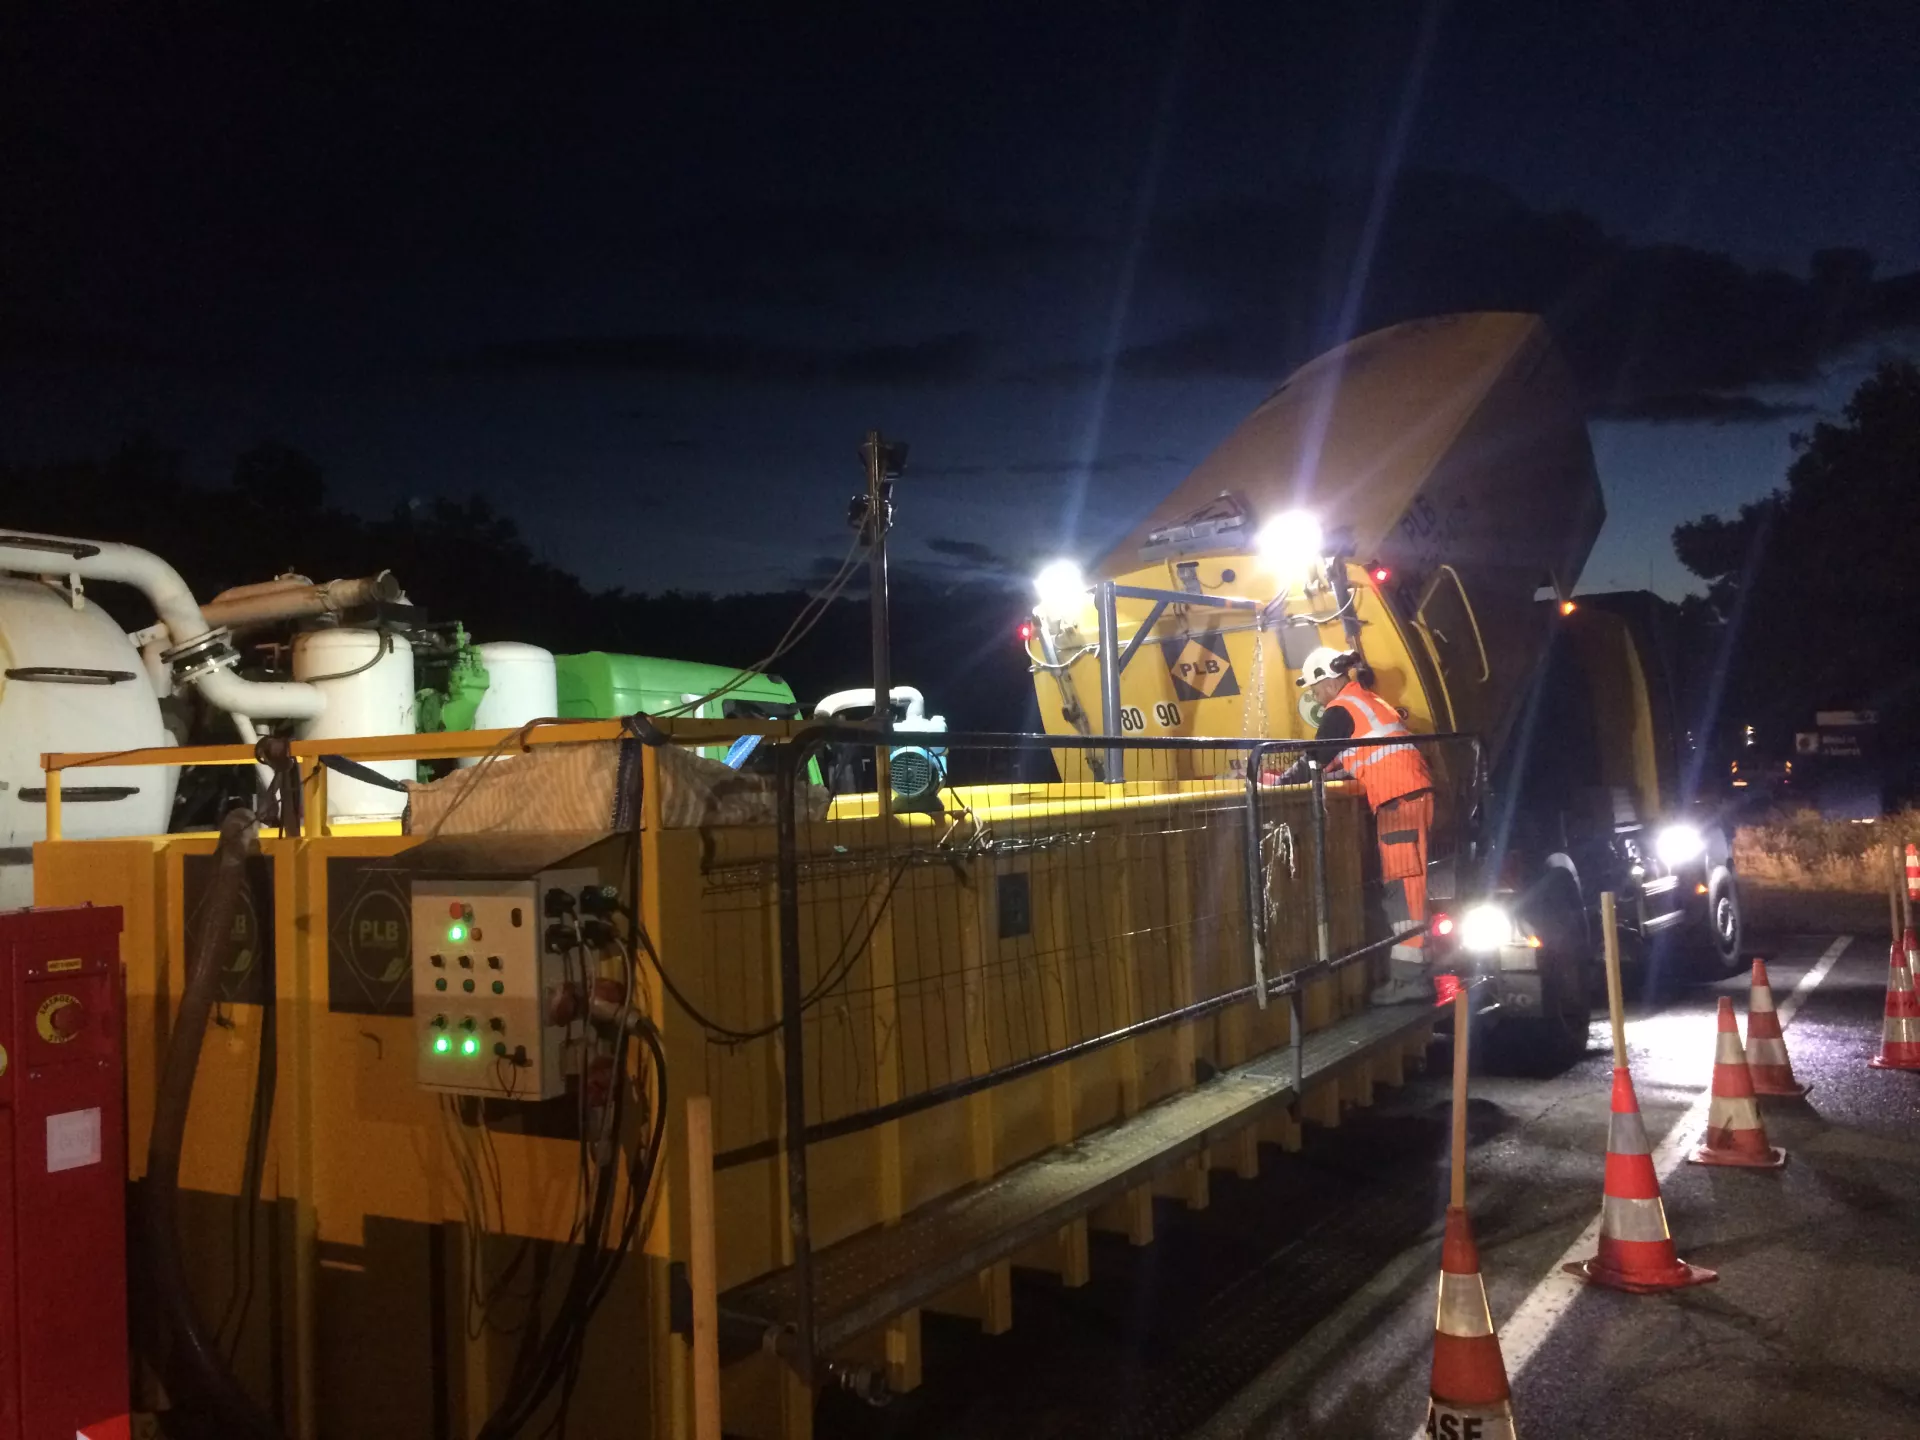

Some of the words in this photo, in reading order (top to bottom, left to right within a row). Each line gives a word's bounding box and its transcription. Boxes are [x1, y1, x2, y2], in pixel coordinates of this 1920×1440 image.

[1180, 659, 1220, 677] PLB
[1120, 707, 1144, 731] 80
[1156, 702, 1181, 727] 90
[359, 920, 399, 941] PLB
